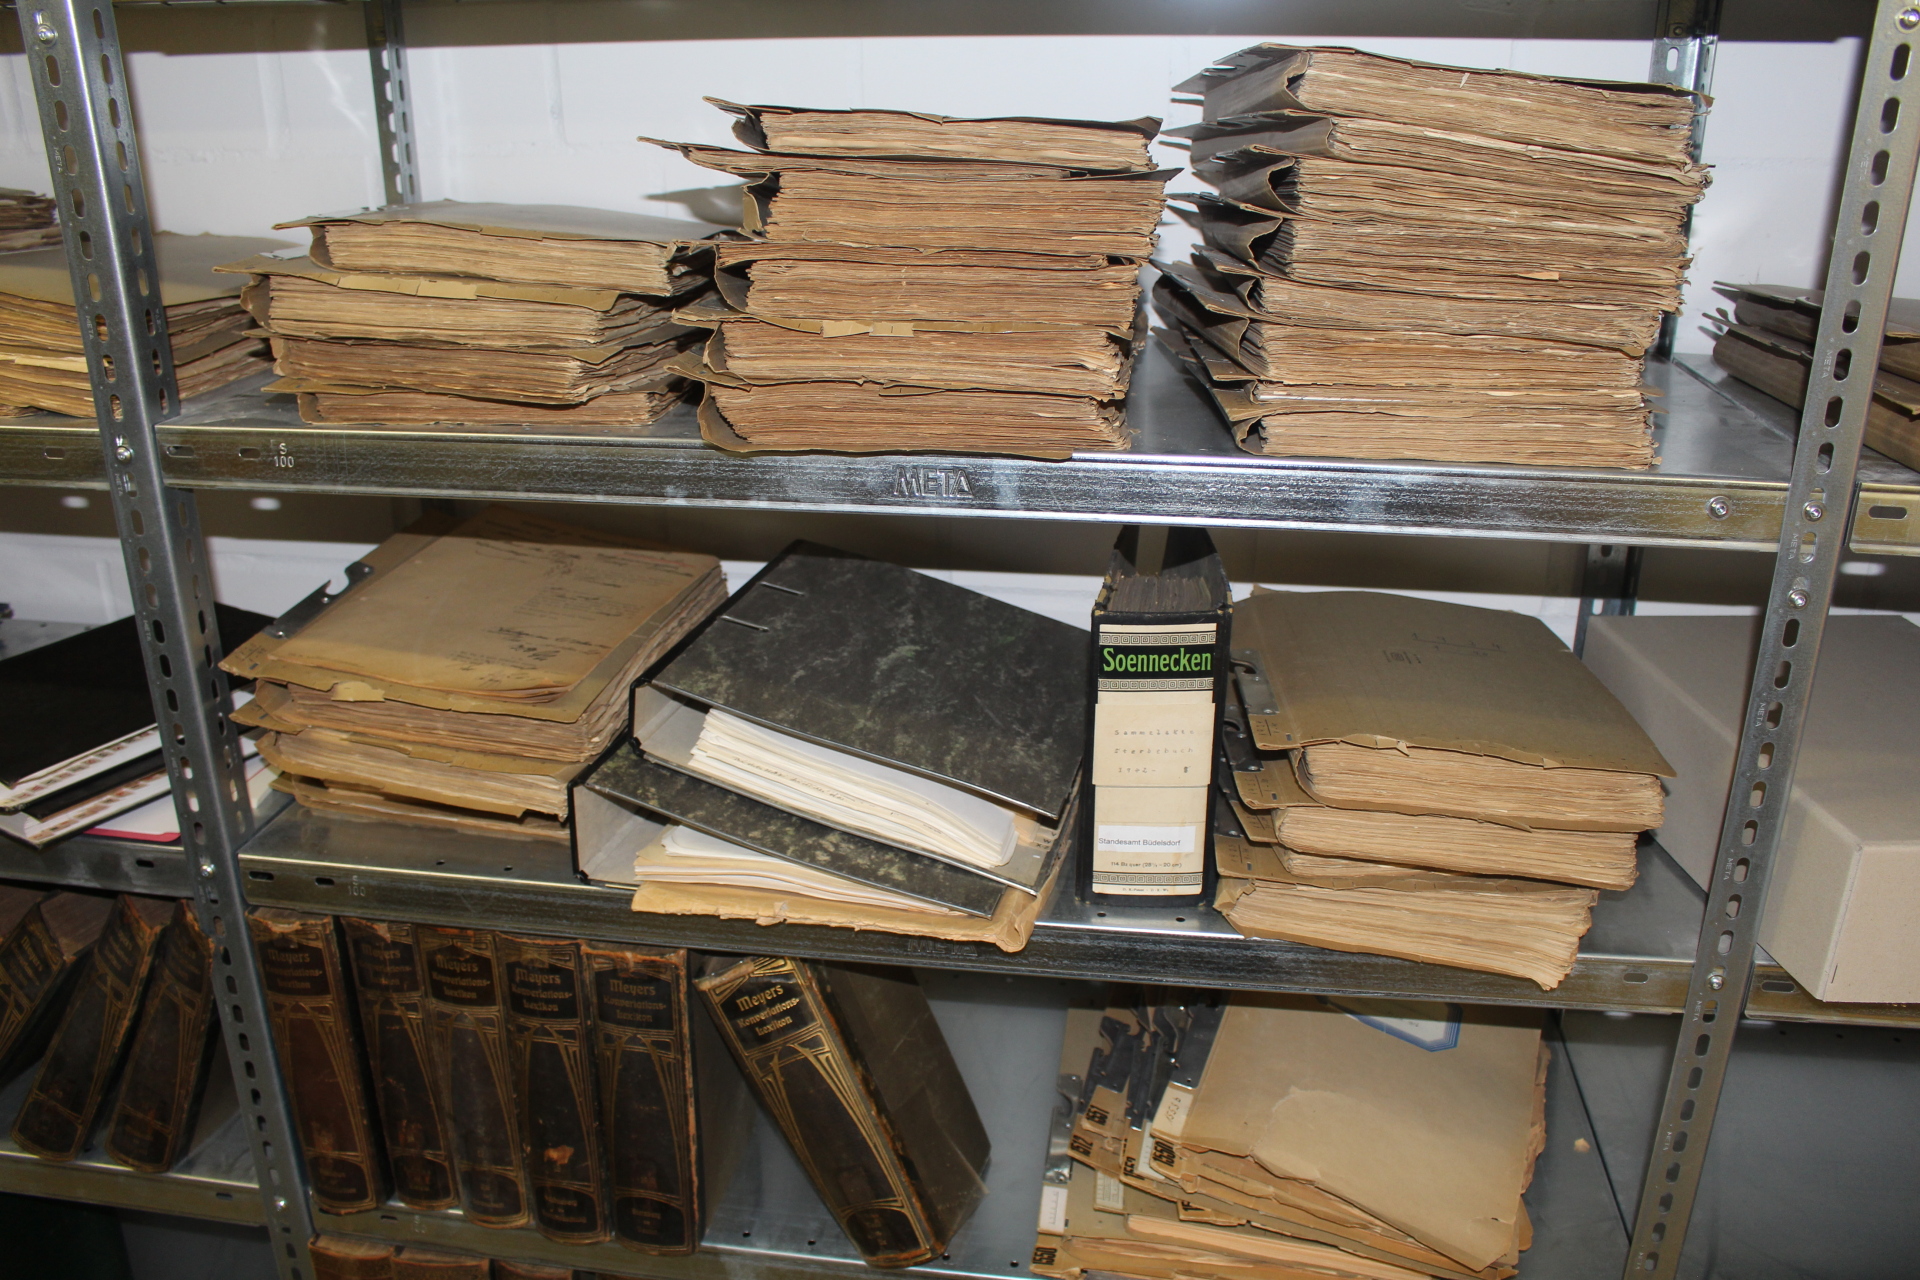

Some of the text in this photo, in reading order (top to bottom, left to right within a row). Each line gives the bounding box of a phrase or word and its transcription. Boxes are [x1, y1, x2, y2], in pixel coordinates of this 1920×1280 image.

[53, 146, 64, 174] META
[85, 314, 94, 340] META
[1821, 349, 1833, 379] META
[279, 442, 288, 455] S
[273, 455, 295, 468] 100
[893, 466, 974, 498] META
[1787, 533, 1799, 560] META
[1102, 647, 1212, 673] Soennecken
[1754, 702, 1766, 728] META
[1098, 837, 1181, 848] Standesamt Büdelsdorf
[1723, 857, 1734, 881] META
[268, 949, 311, 965] Meyers
[436, 955, 479, 974] Meyers
[515, 967, 561, 986] Meyers
[609, 979, 656, 997] Meyers
[736, 984, 784, 1012] Meyers
[1085, 1104, 1110, 1126] 1551
[1032, 1246, 1058, 1266] 1550
